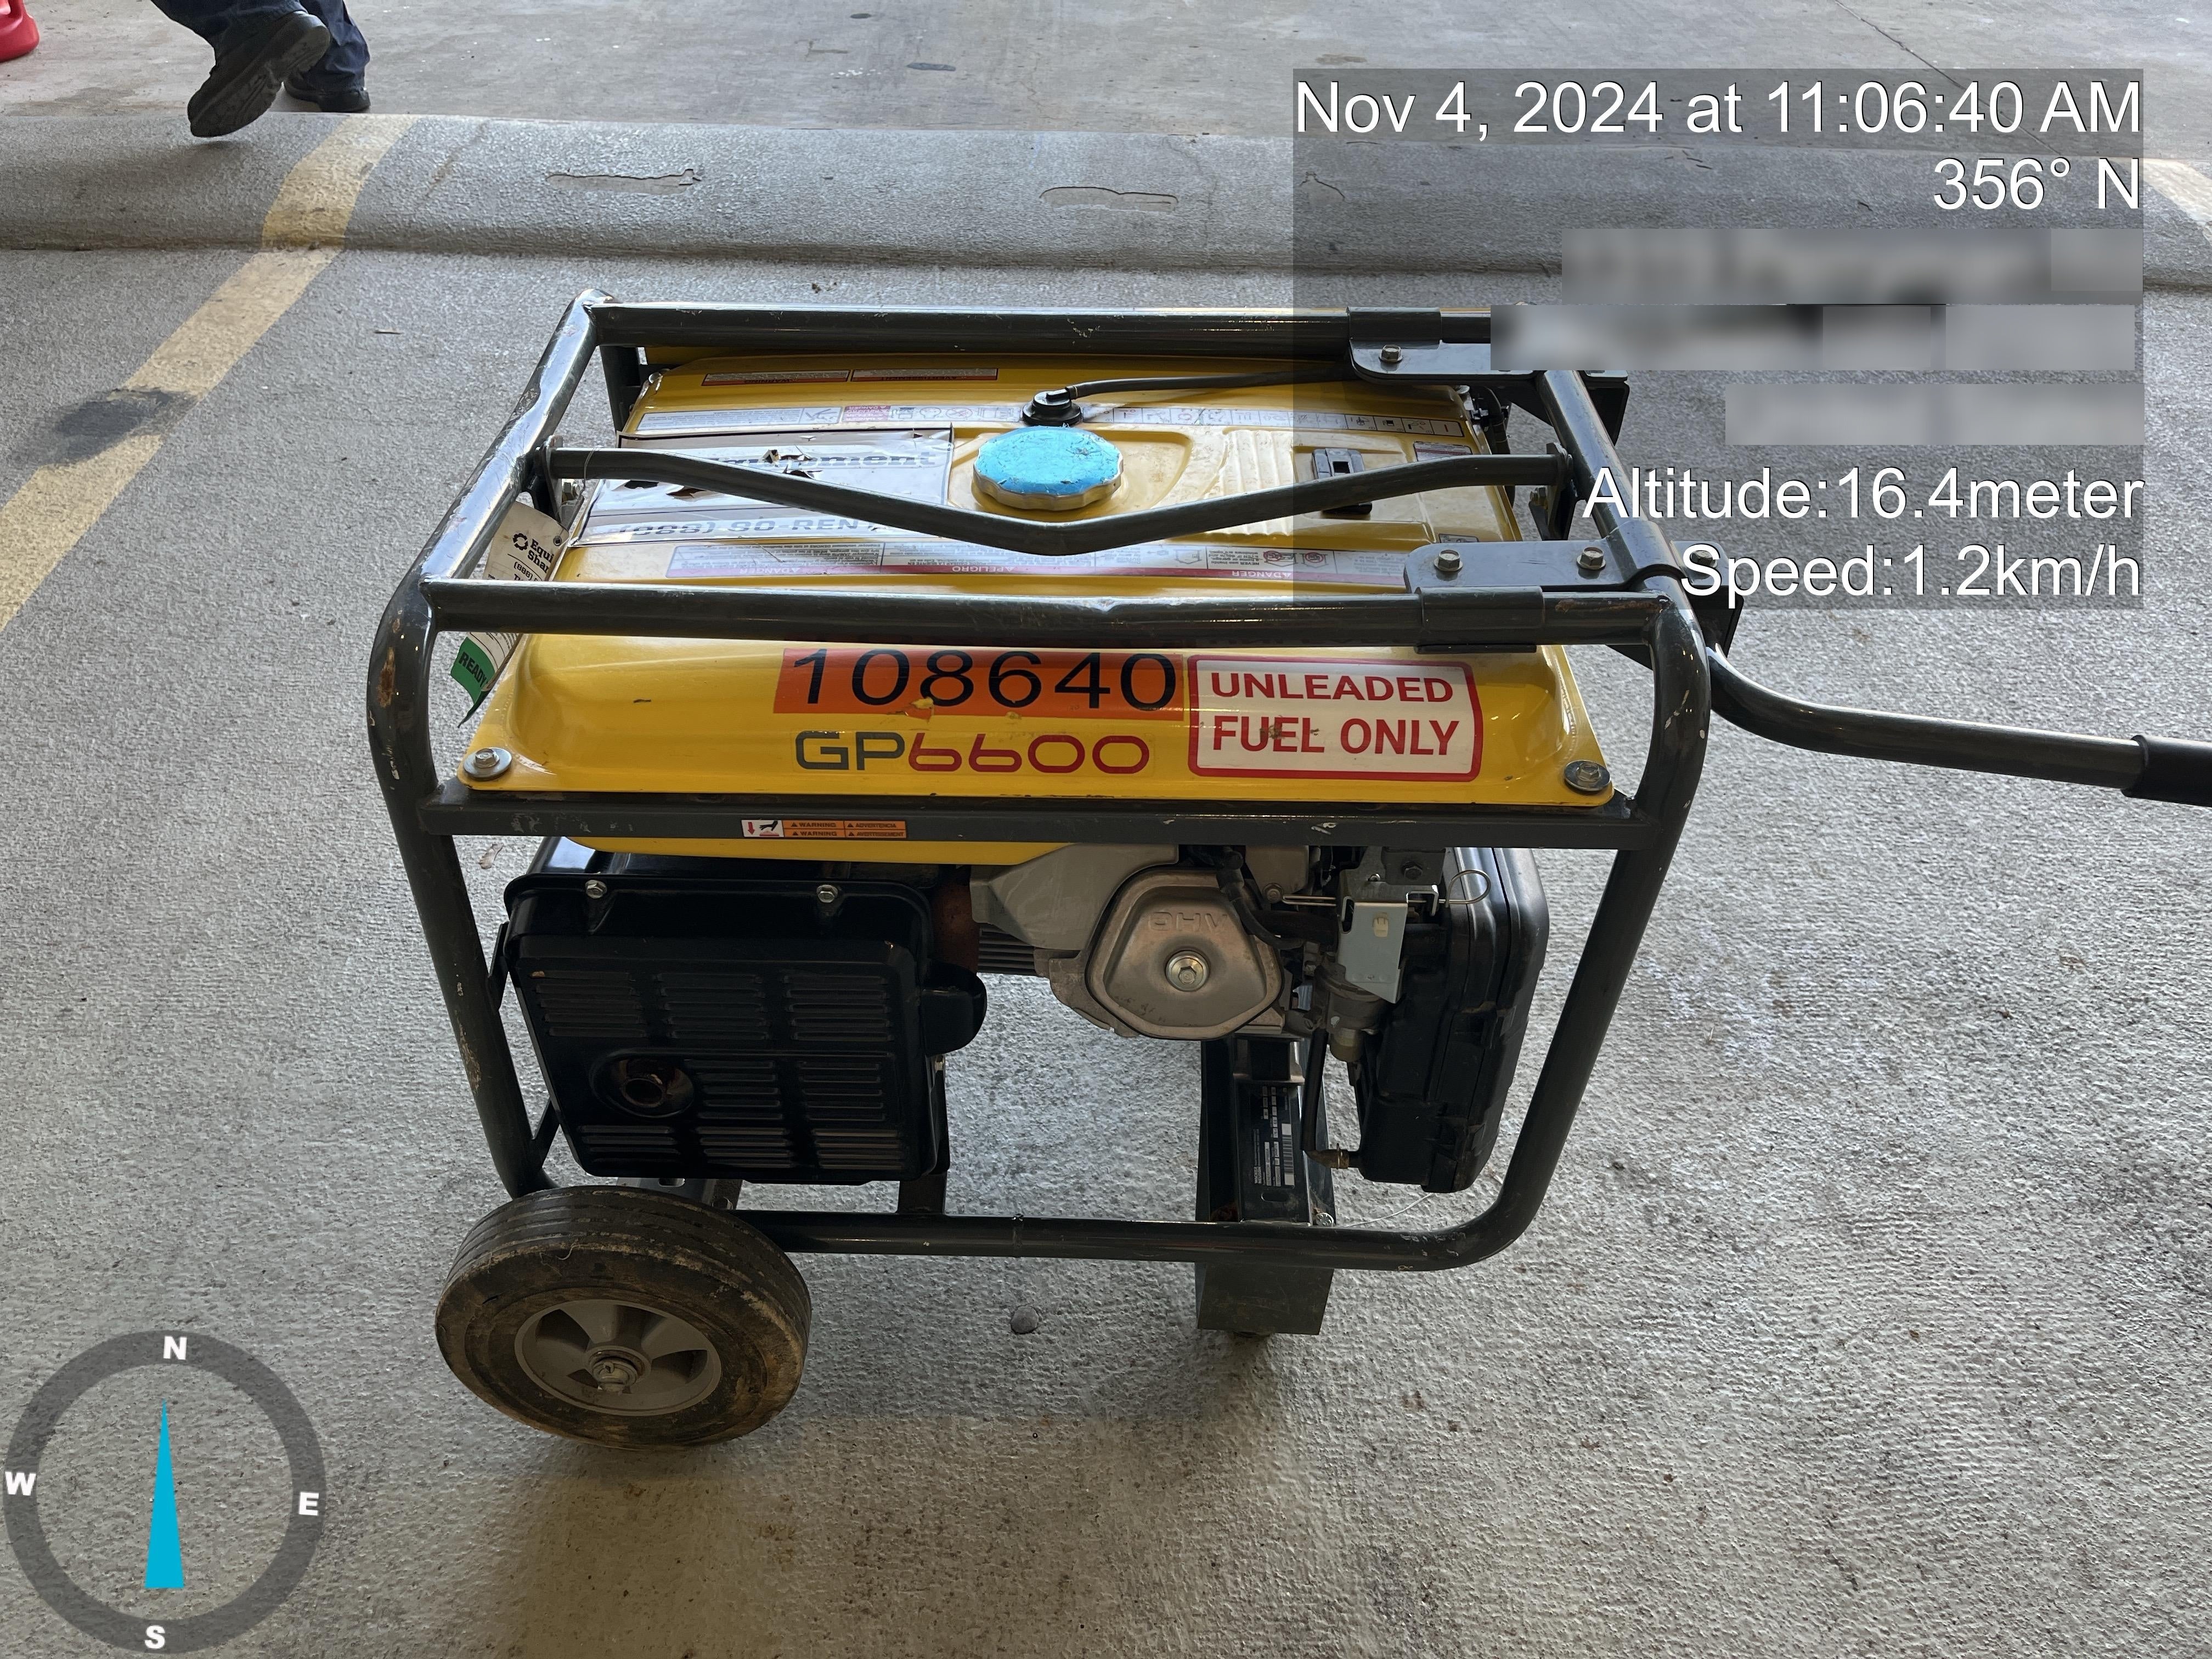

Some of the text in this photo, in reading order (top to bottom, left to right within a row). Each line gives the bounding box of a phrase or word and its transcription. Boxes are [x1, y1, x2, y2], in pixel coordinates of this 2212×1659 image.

[459, 651, 487, 687] READY
[794, 648, 1176, 709] 108640
[1211, 673, 1453, 702] UNLEADED
[795, 730, 1150, 774] GP6600
[1213, 715, 1460, 755] FUEL ONLY
